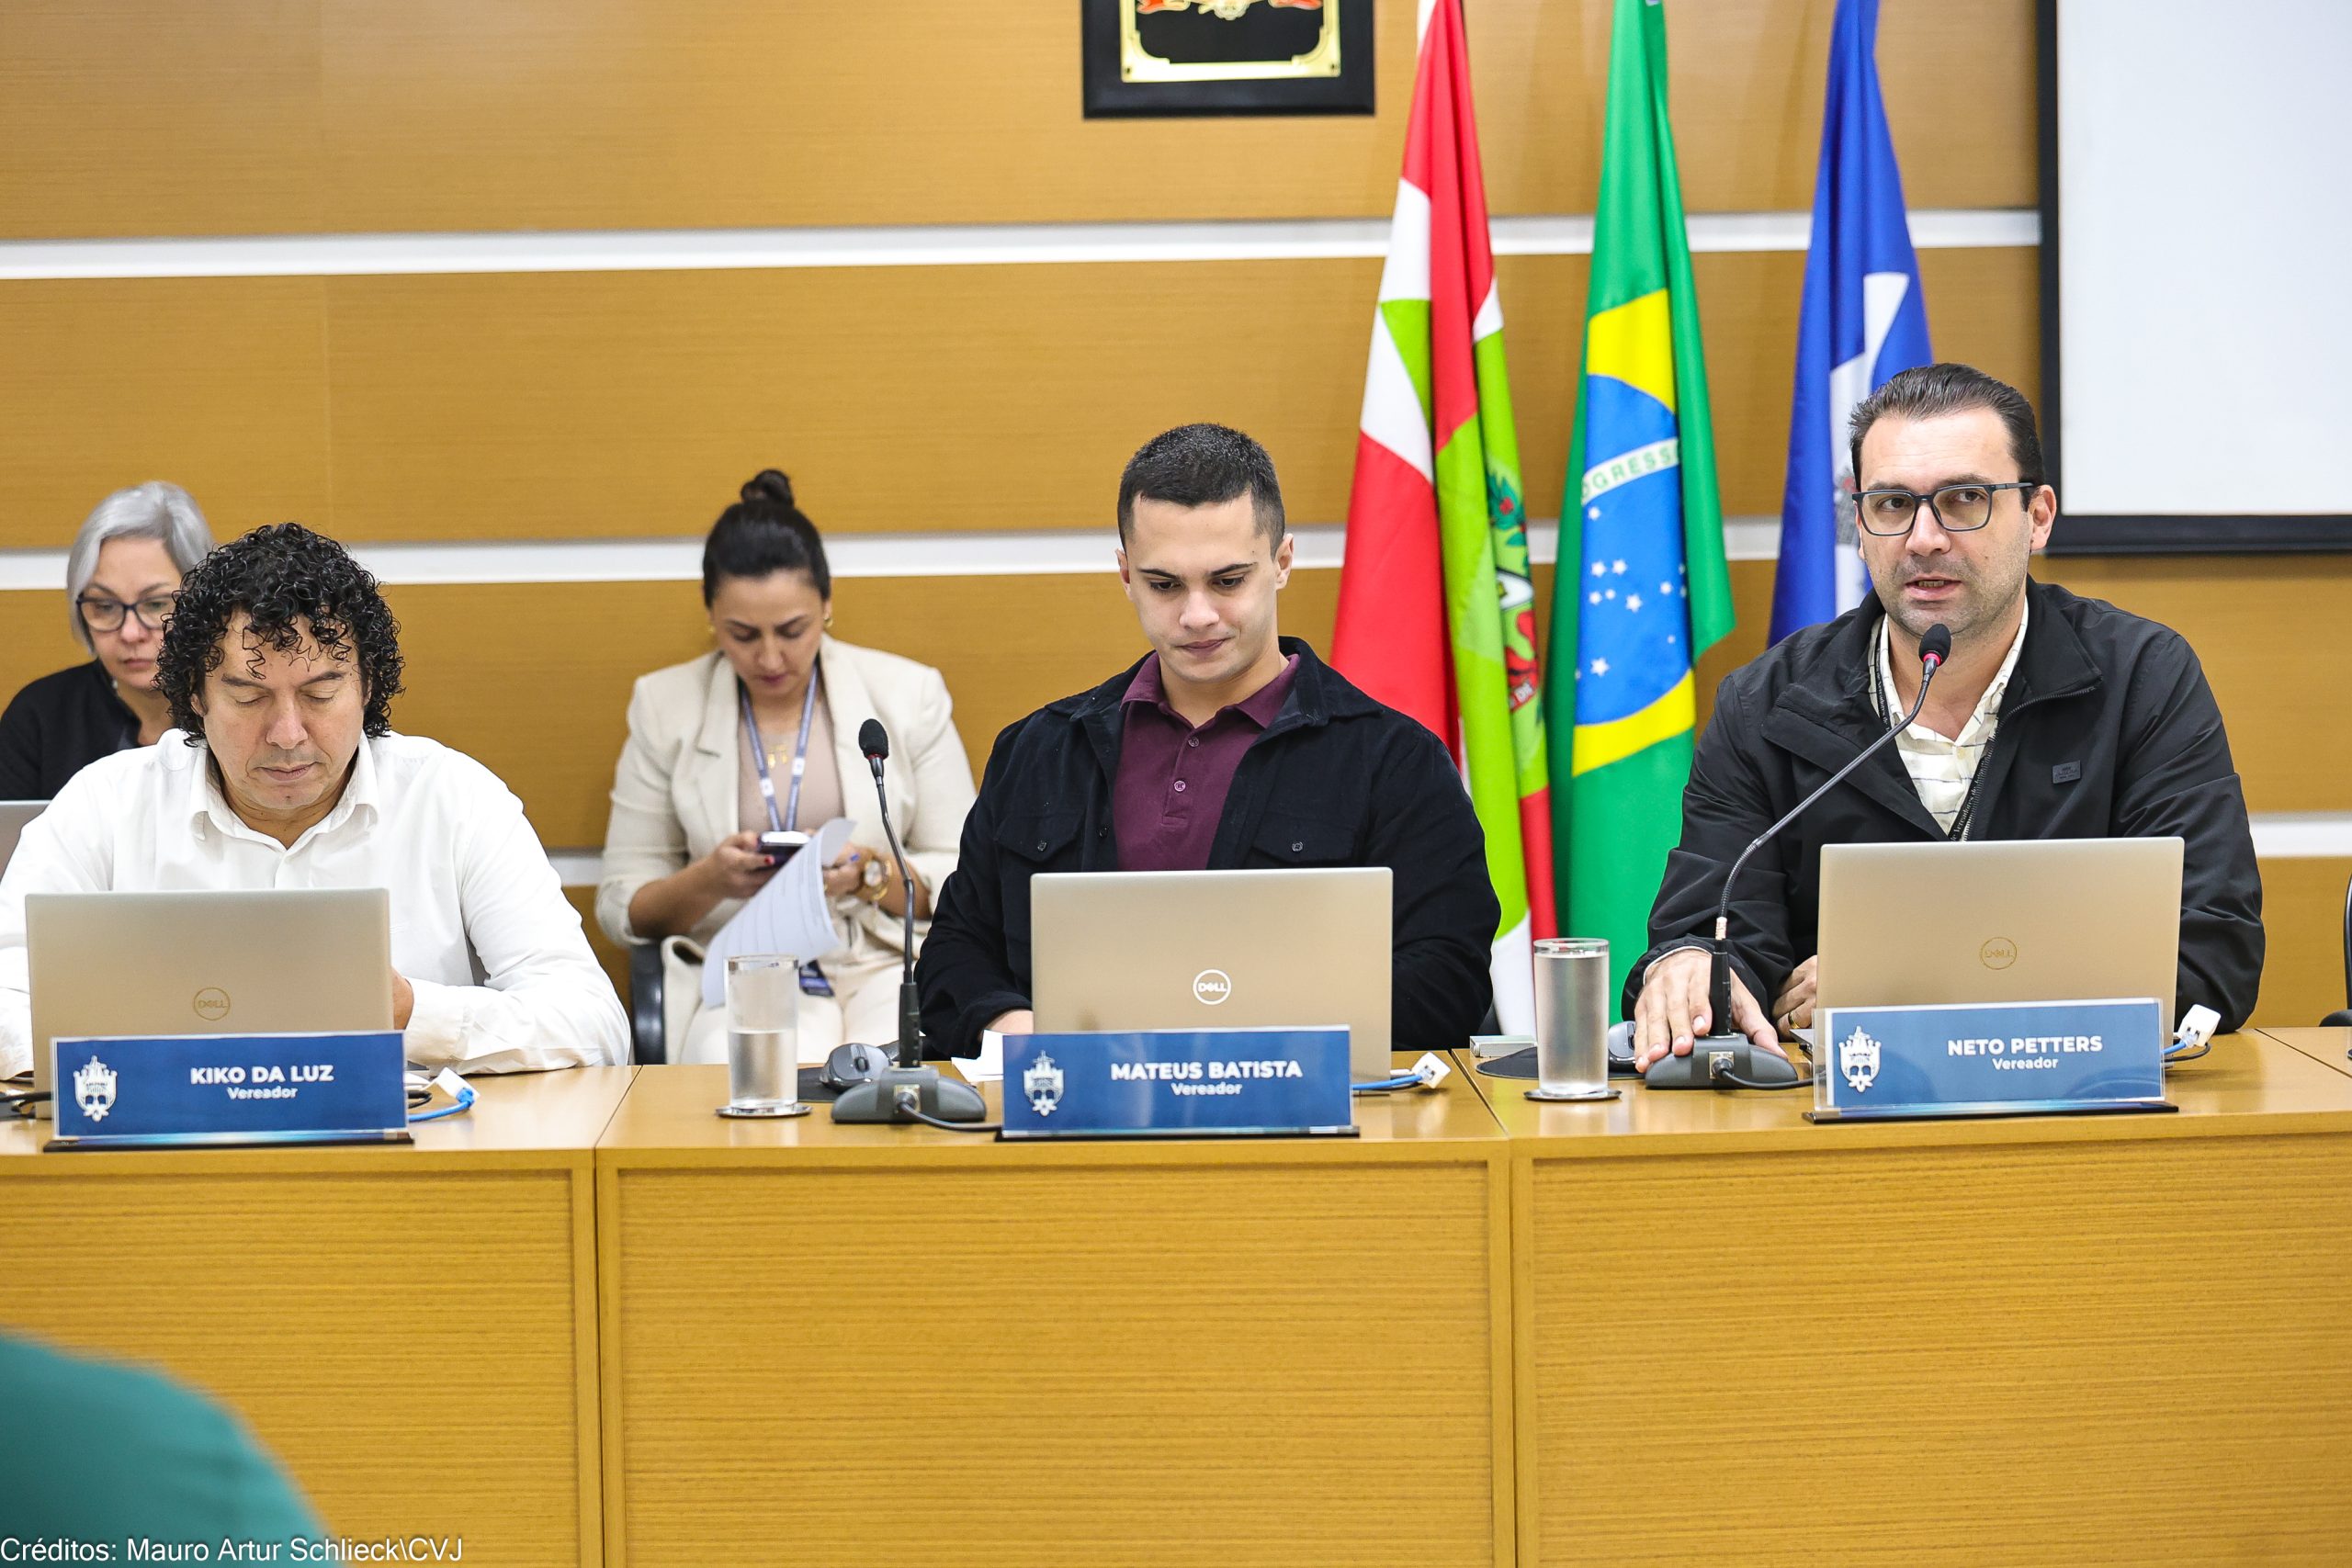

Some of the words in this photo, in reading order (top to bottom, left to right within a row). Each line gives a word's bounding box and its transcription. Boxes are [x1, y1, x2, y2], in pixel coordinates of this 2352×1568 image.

[1947, 1038, 2005, 1056] NETO
[2010, 1035, 2103, 1055] PETTERS
[1110, 1062, 1203, 1081] MATEUS
[1208, 1060, 1303, 1079] BATISTA
[1992, 1056, 2059, 1070] Vereador
[190, 1066, 246, 1085] KIKO
[252, 1066, 286, 1083] DA
[290, 1065, 334, 1082] LUZ
[227, 1086, 298, 1100] Vereador
[1170, 1081, 1242, 1096] Vereador
